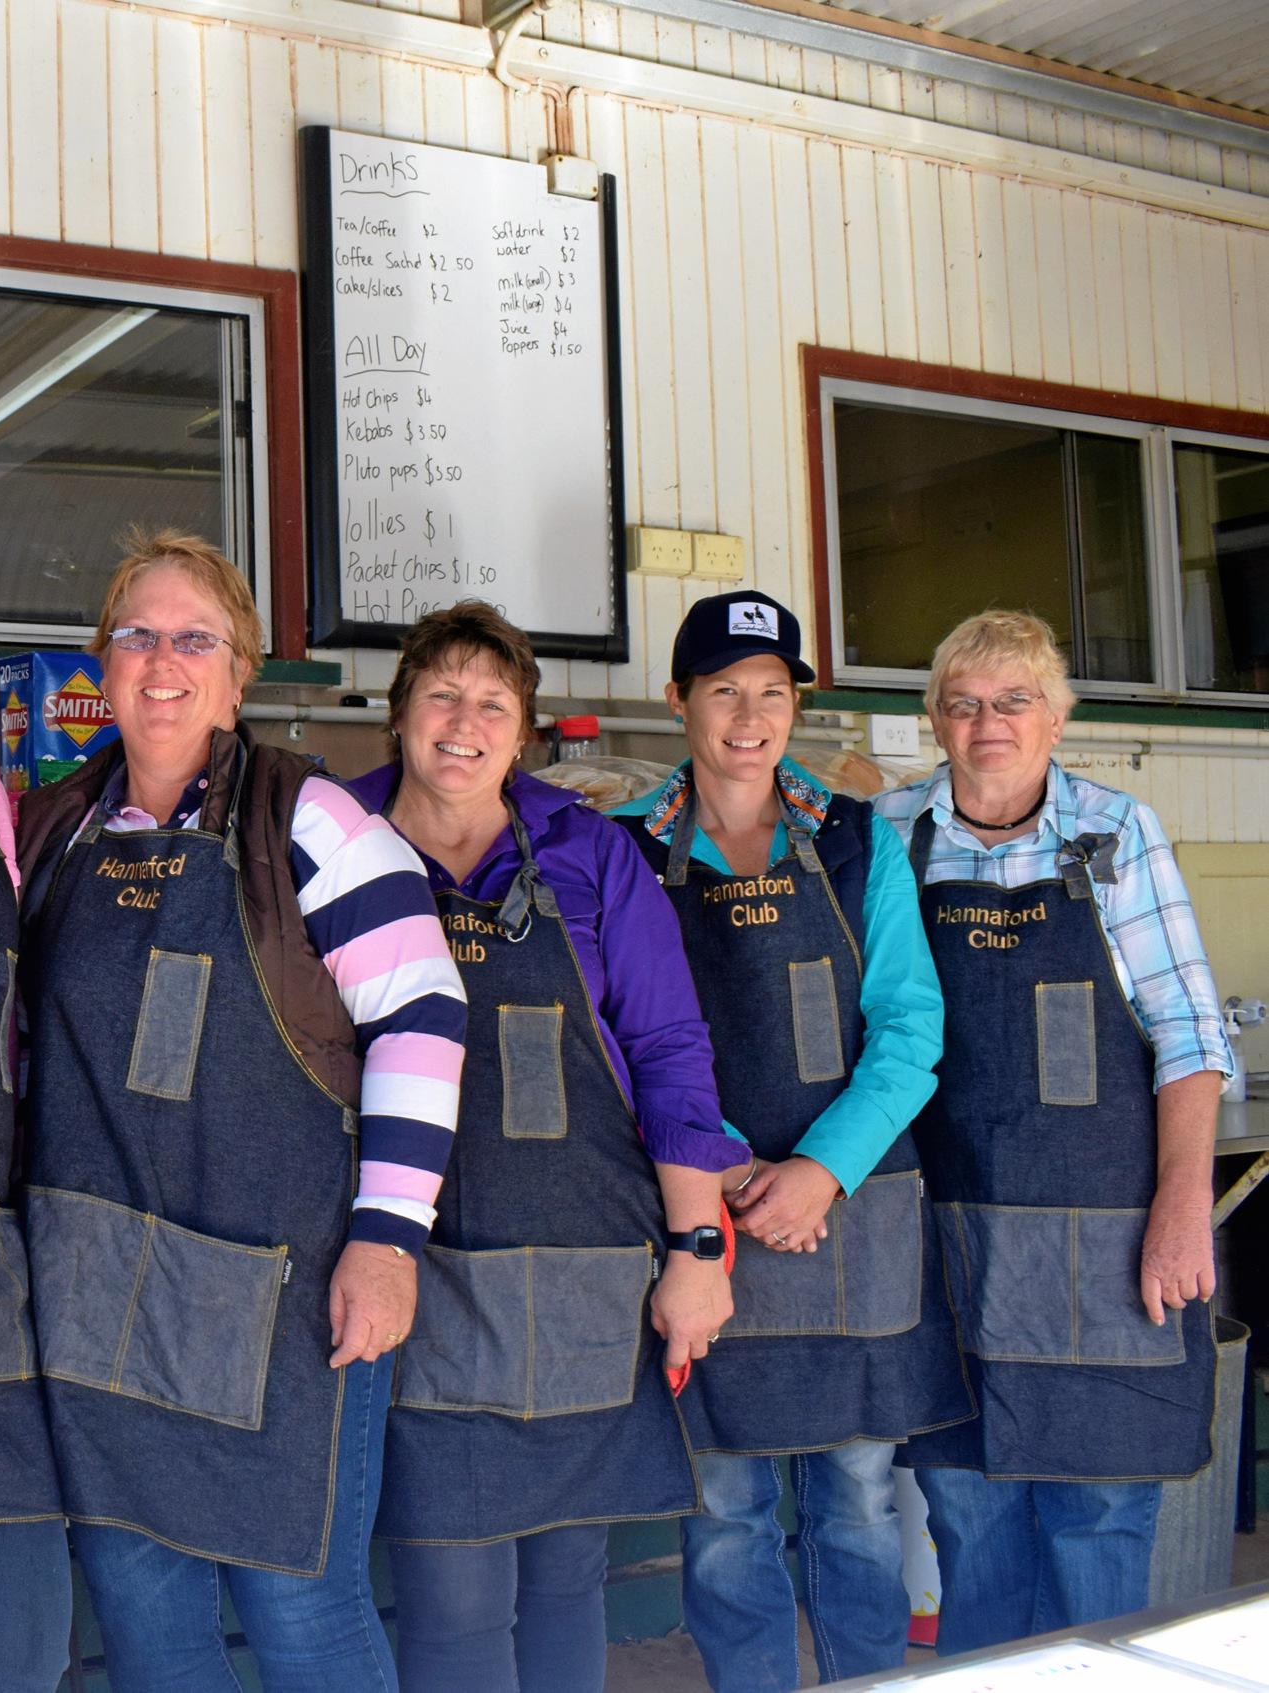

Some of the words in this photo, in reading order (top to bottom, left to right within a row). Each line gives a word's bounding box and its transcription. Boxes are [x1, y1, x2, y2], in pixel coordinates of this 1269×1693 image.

[339, 152, 418, 188] Drinks
[423, 223, 438, 238] $2
[563, 225, 579, 241] $2
[335, 246, 374, 267] Coffee
[561, 246, 576, 263] $2
[558, 271, 575, 288] $3
[431, 283, 453, 304] $2
[554, 295, 572, 316] $4
[499, 319, 531, 334] Juice
[553, 321, 568, 340] $4
[345, 334, 381, 366] All
[392, 335, 427, 372] Day
[501, 336, 539, 358] Poppers
[342, 387, 361, 409] Hot
[417, 385, 433, 408] $4
[346, 417, 393, 443] Kebabs
[344, 454, 381, 481] Pluto
[389, 463, 418, 492] pups
[346, 549, 398, 583] Packet
[354, 590, 391, 622] Hot
[0, 664, 11, 684] 20
[11, 669, 30, 681] PACKS
[96, 853, 187, 880] Hannafod
[731, 902, 779, 927] Club
[937, 902, 1048, 927] Hannaford
[448, 938, 486, 962] lub
[968, 929, 1020, 949] Club
